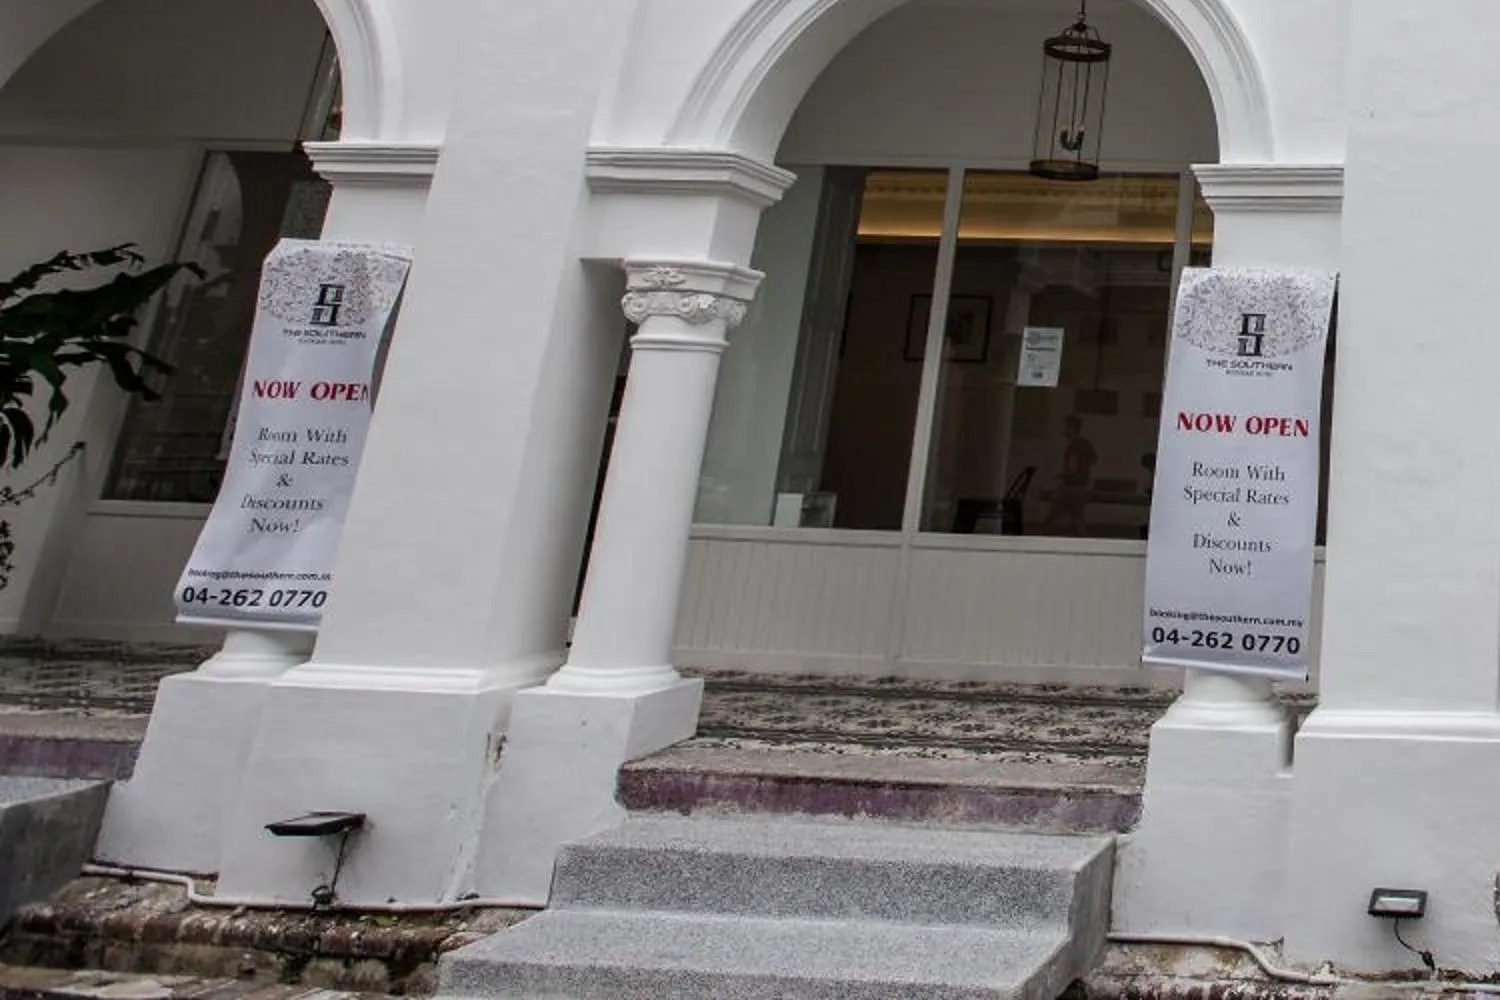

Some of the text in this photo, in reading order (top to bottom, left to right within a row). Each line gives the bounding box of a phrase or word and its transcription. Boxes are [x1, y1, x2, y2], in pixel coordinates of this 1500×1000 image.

[1206, 359, 1293, 371] THE SOUTHERN
[252, 380, 302, 399] NOW
[1177, 411, 1309, 437] NOW OPEN
[259, 427, 348, 444] Room With
[248, 449, 349, 468] Special Rates
[276, 473, 293, 488] &
[1192, 461, 1286, 481] Room With
[240, 494, 324, 511] Discounts
[1183, 486, 1290, 505] Special Rates
[249, 517, 300, 534] Now!
[1227, 511, 1241, 527] &
[1193, 532, 1272, 553] Discounts
[1209, 559, 1252, 576] Now!
[182, 587, 327, 608] 04-262 0770
[1152, 626, 1301, 655] 04-262 0770
